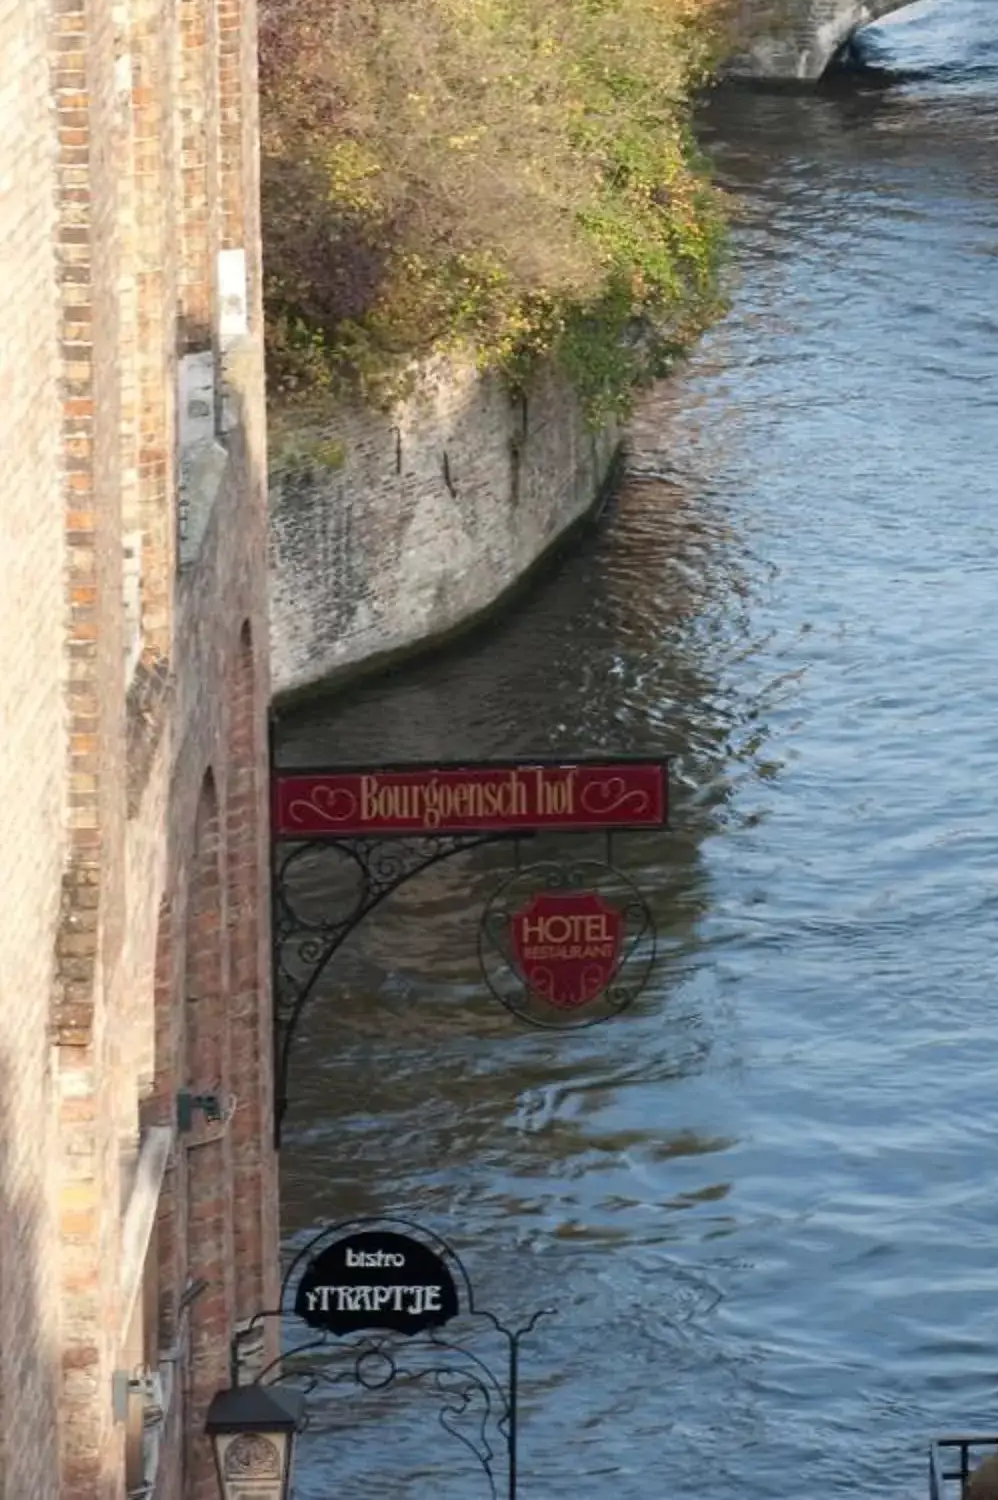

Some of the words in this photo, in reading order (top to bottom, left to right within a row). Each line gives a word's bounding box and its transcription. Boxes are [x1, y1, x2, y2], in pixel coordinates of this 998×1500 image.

[361, 771, 526, 828] Bourgoensch
[537, 770, 579, 814] hof
[522, 914, 613, 942] HOTEL
[346, 1248, 404, 1267] bistro
